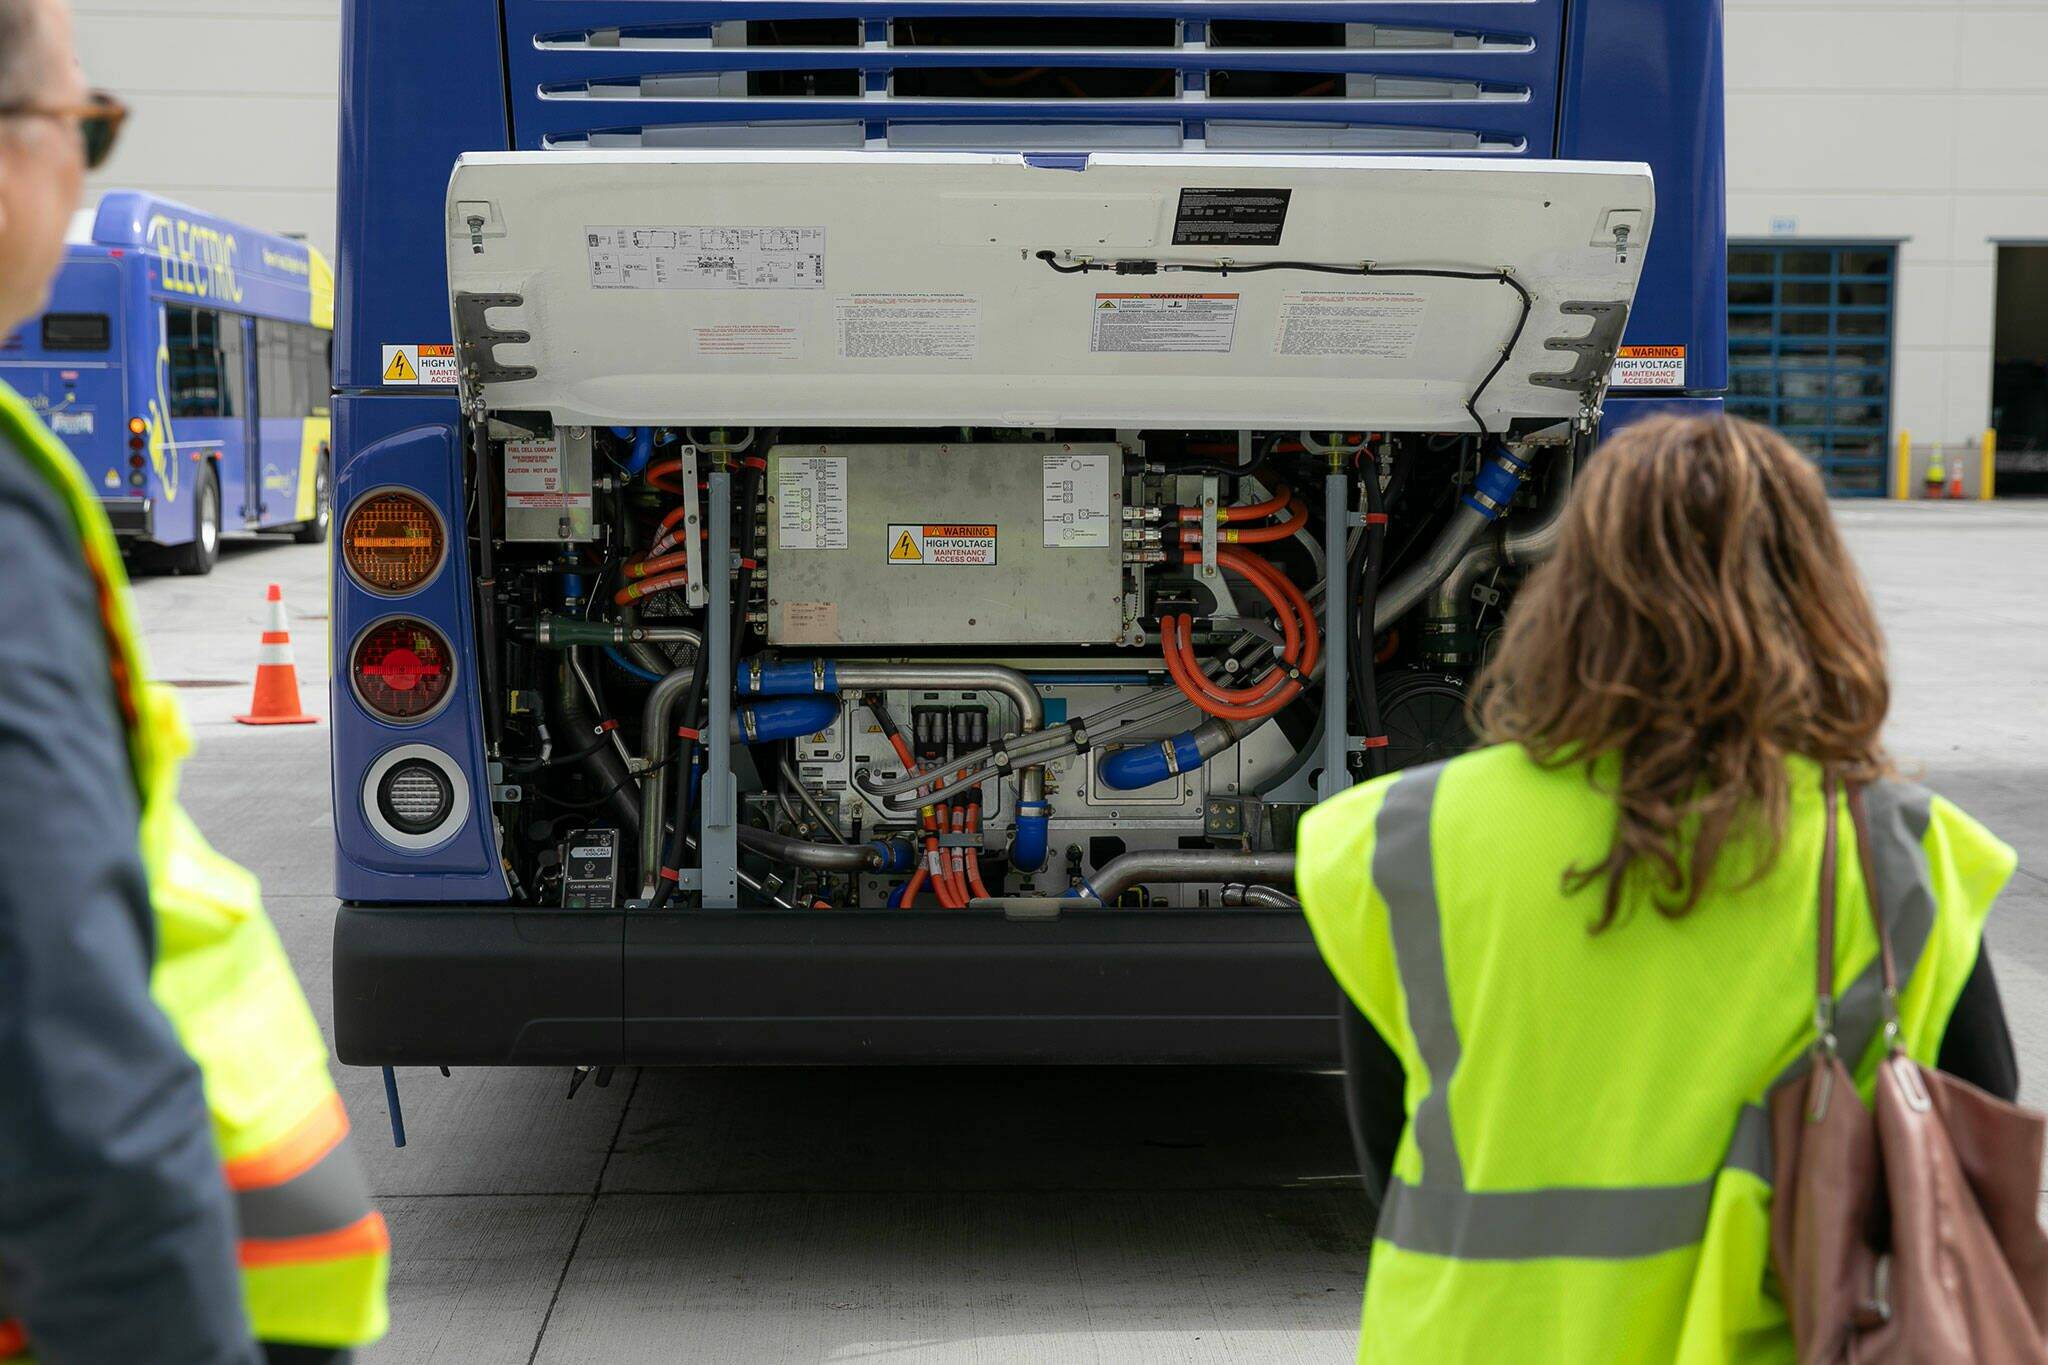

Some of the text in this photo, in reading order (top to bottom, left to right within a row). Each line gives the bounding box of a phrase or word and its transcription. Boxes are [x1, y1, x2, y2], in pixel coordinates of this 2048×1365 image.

[147, 214, 243, 304] ELECTRIC
[1632, 348, 1679, 357] WARNING
[926, 540, 993, 548] HIGH VOLTAGE
